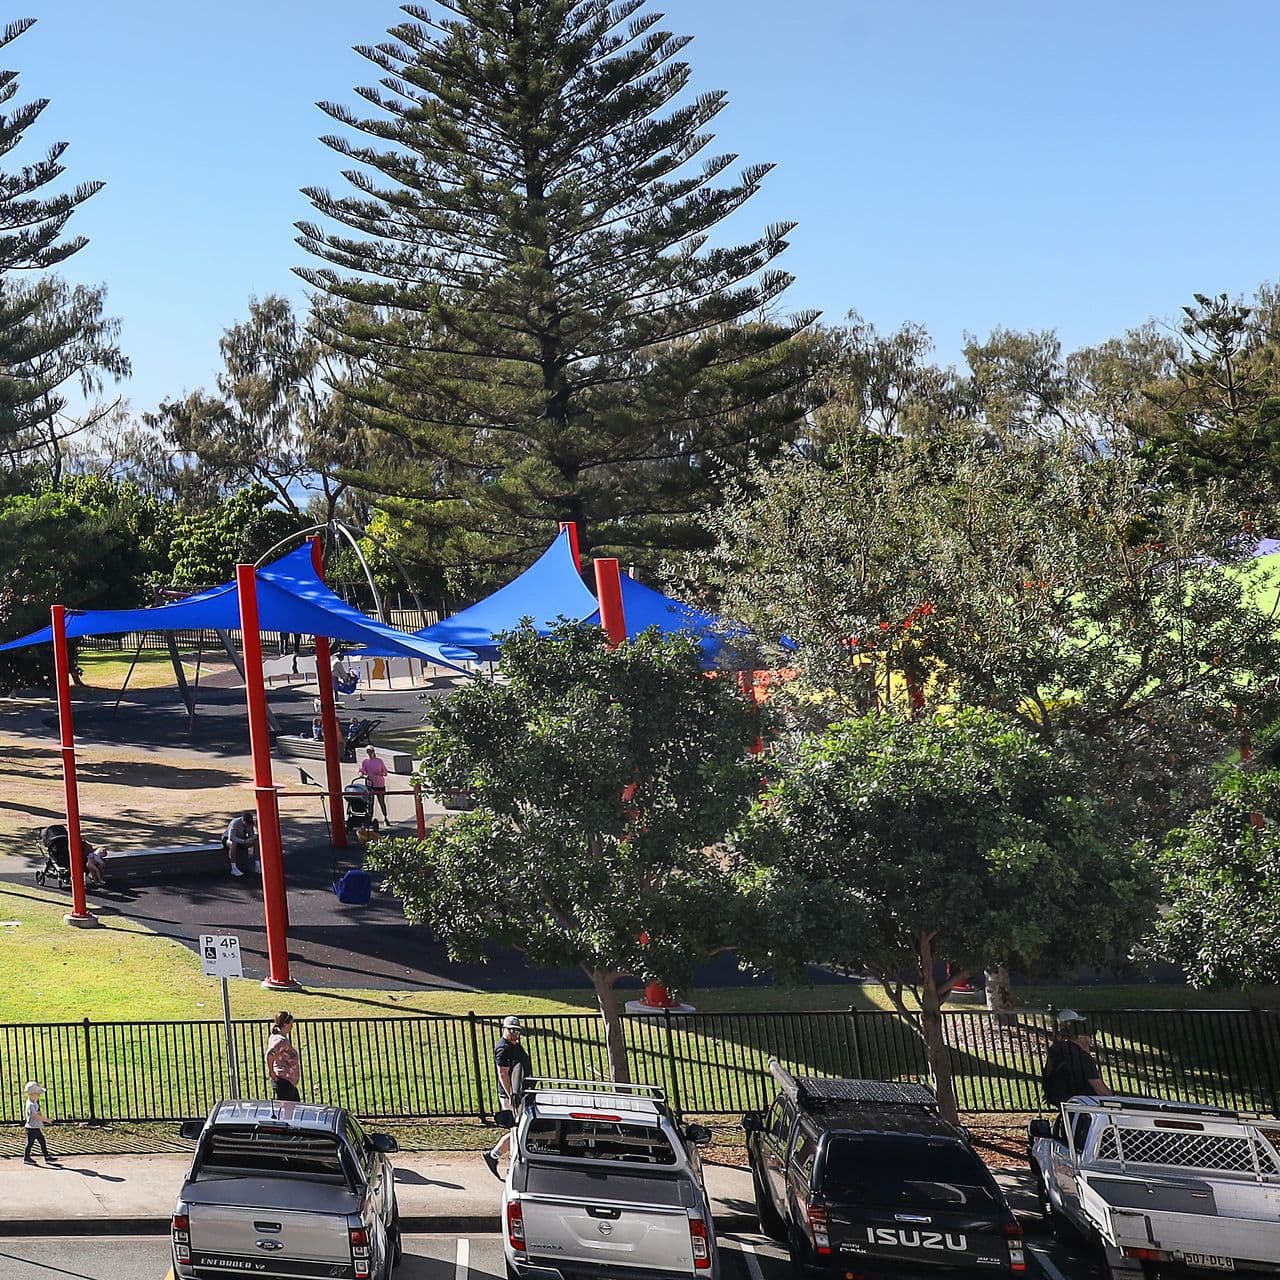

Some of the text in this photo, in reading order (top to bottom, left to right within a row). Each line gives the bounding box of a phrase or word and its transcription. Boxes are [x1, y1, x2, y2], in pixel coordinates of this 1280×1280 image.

[205, 936, 214, 946] P
[220, 938, 237, 948] 4P
[866, 1227, 967, 1251] ISUZU
